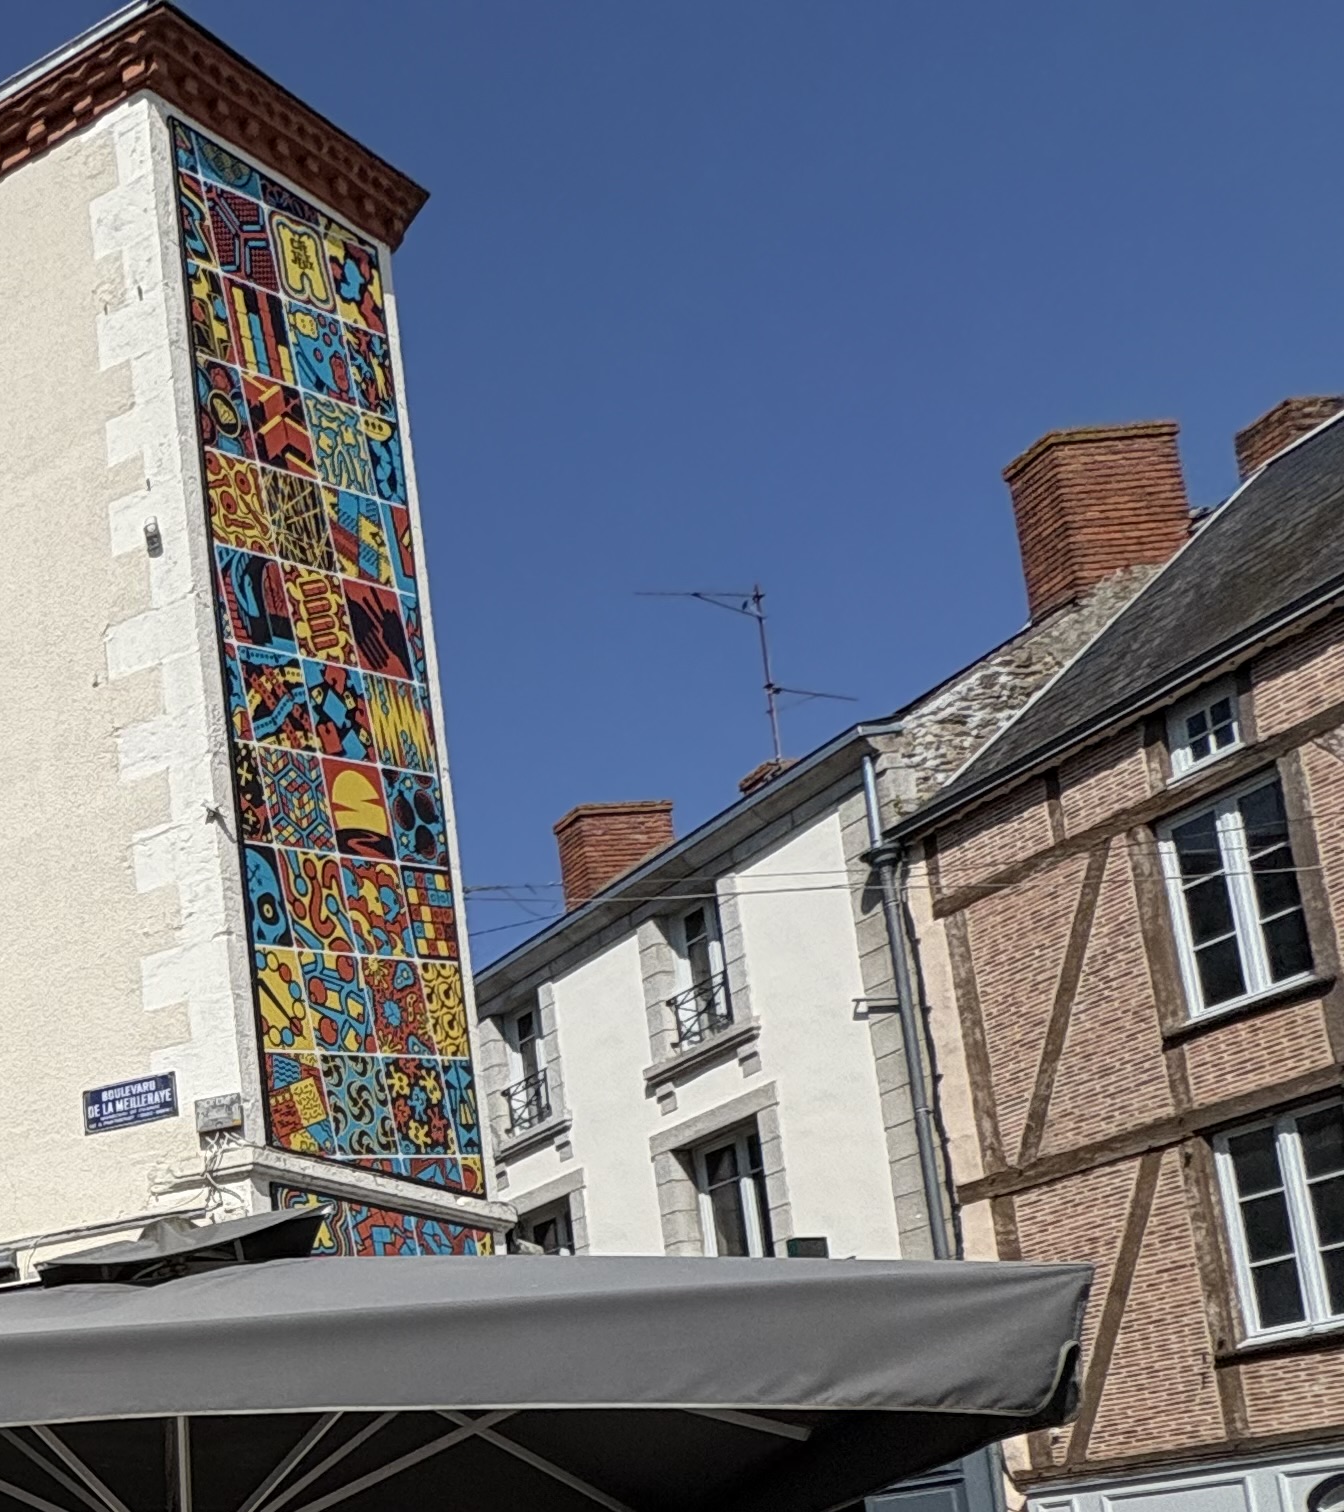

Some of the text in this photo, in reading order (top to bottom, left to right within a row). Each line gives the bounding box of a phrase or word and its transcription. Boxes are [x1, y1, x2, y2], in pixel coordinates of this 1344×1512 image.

[87, 1104, 101, 1119] DE
[102, 1101, 114, 1116] LA
[115, 1088, 172, 1113] MEILLERAYE
[101, 1080, 156, 1102] BOULEVARD
